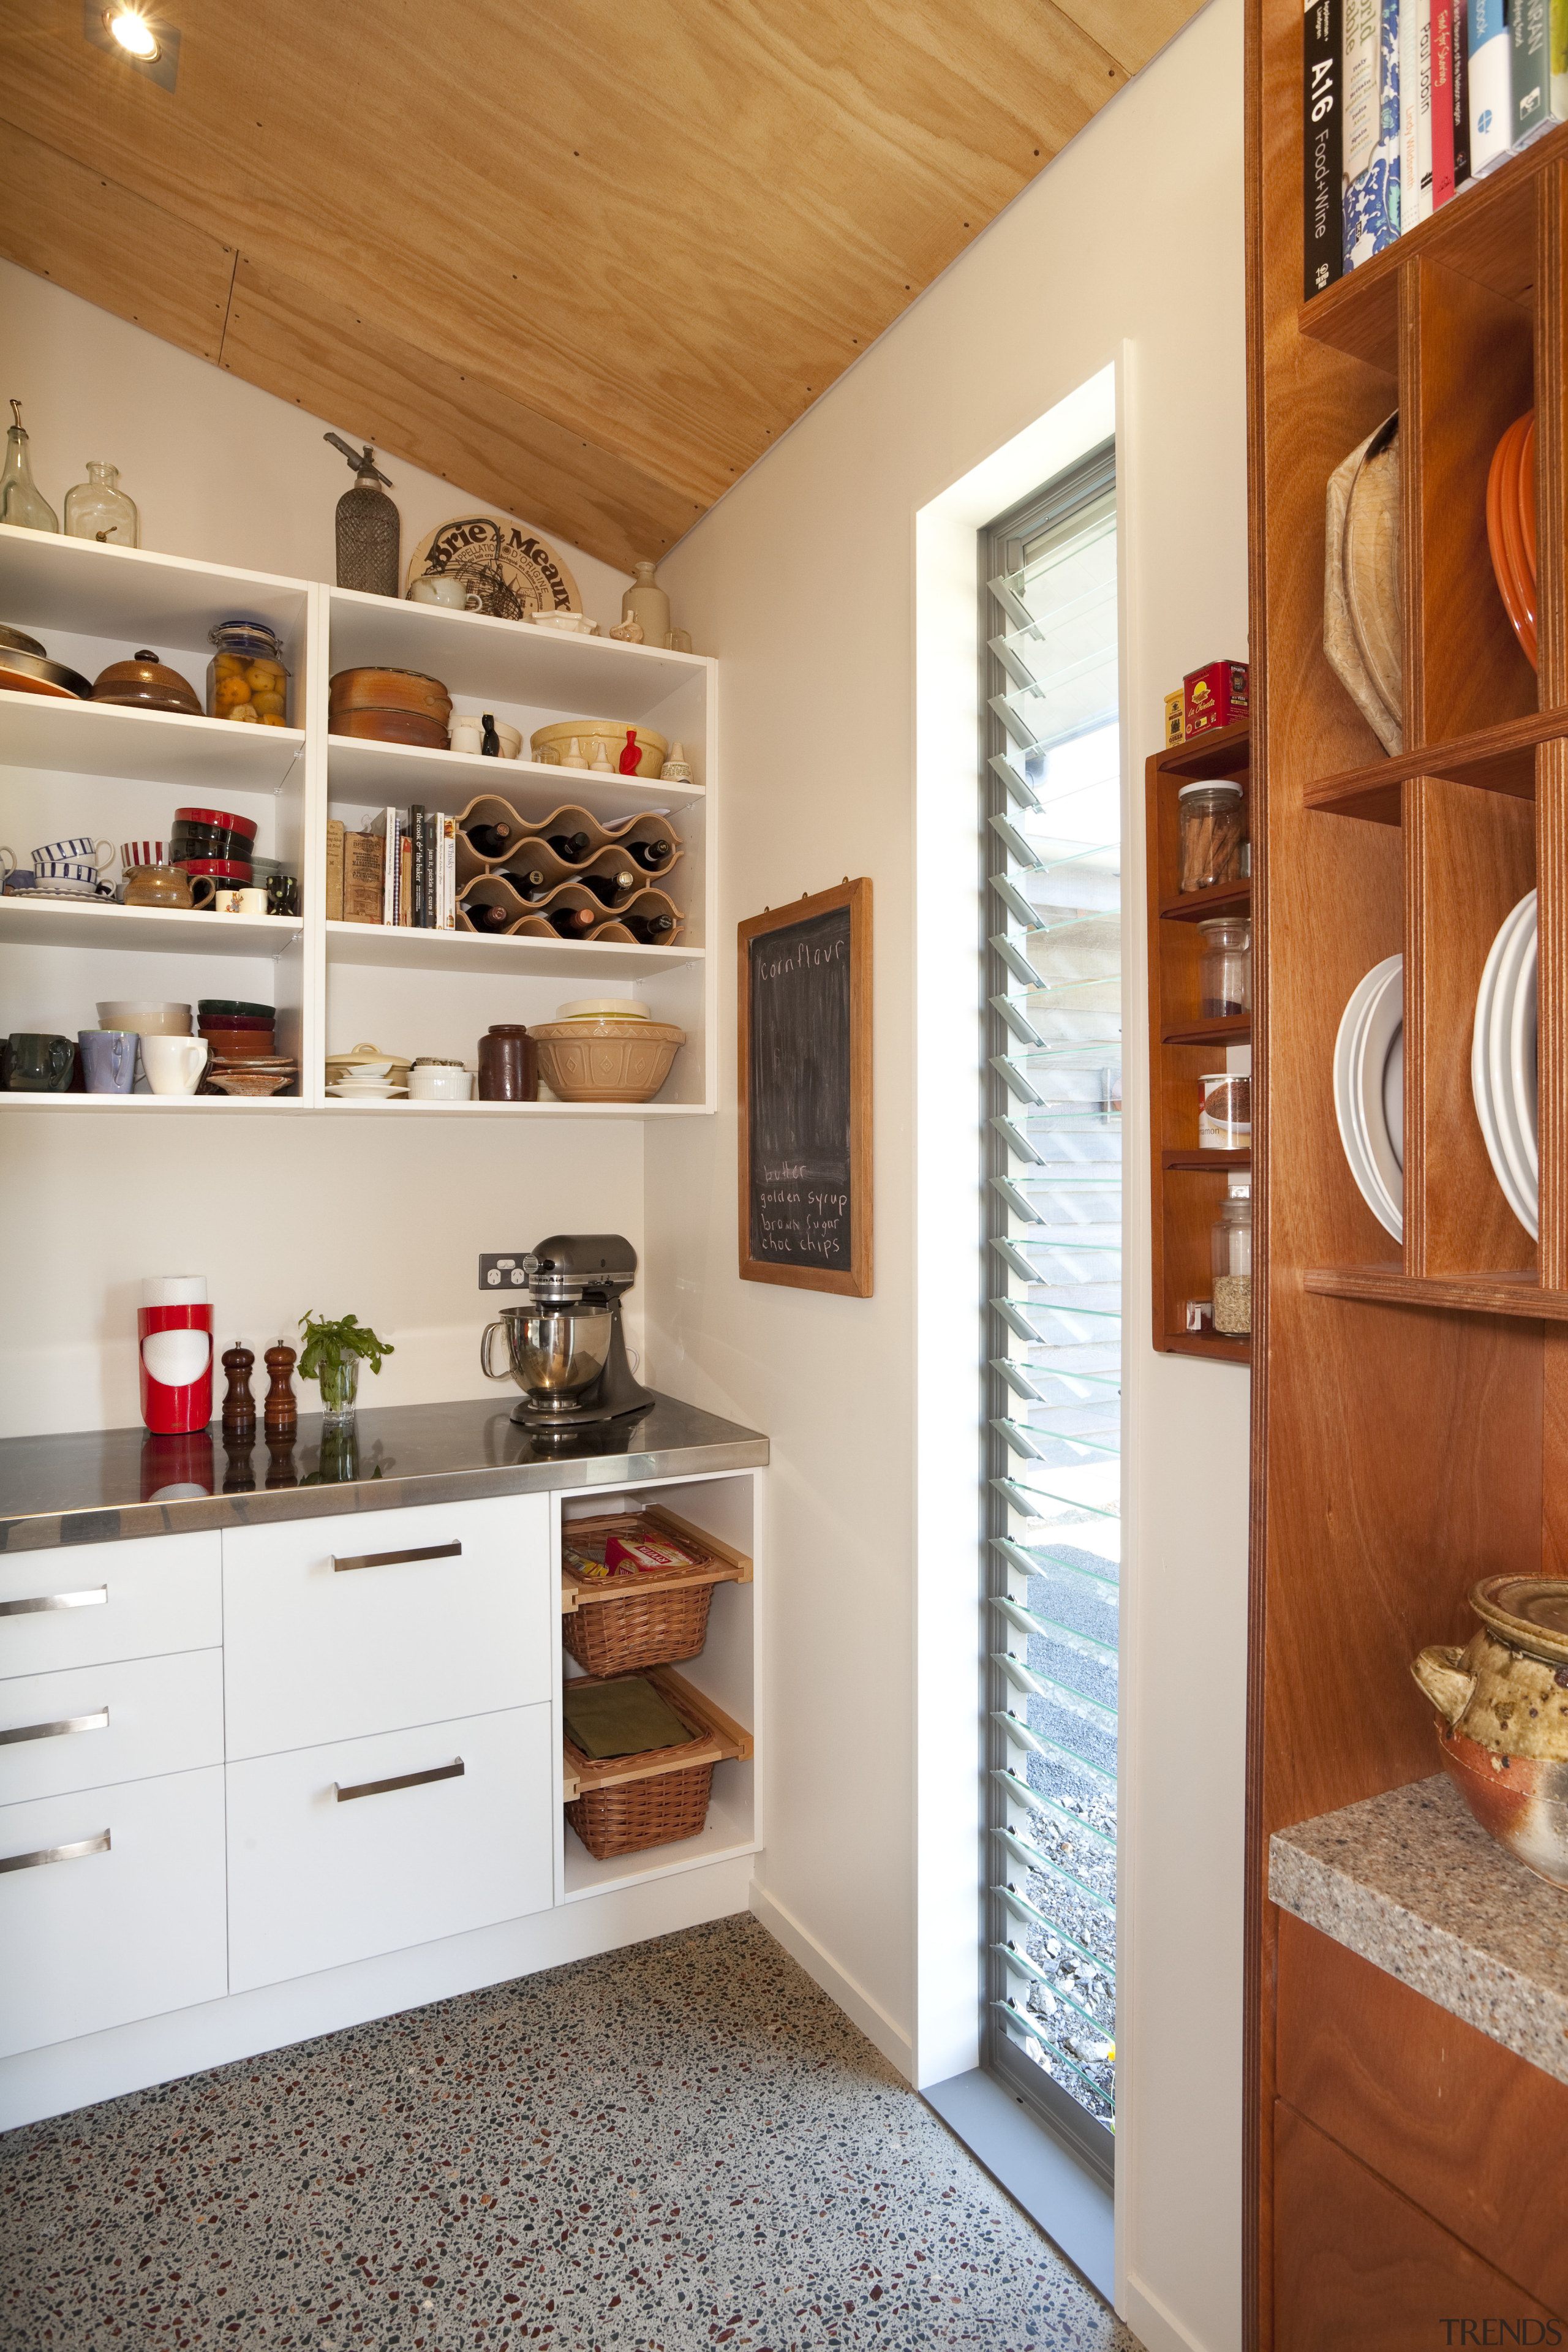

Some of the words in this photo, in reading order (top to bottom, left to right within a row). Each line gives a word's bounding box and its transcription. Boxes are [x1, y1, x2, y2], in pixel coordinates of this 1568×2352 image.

[1420, 22, 1431, 62] Paul
[1434, 46, 1449, 86] Sharing
[1311, 58, 1333, 123] A16
[1350, 78, 1371, 99] Britain
[1420, 67, 1431, 115] Jobin
[1352, 104, 1367, 121] India
[1353, 113, 1366, 127] Asia
[1404, 105, 1415, 135] Lindy
[1350, 134, 1370, 153] Mexico
[1351, 128, 1367, 145] Spain
[1406, 138, 1415, 190] Wildsmith
[1314, 128, 1329, 239] Food+Wine
[424, 525, 488, 567] Brie
[507, 528, 571, 611] Meaux
[500, 554, 518, 566] briqué
[524, 570, 537, 586] Seine
[511, 550, 549, 594] D'ORIGINE
[1169, 711, 1183, 721] MUSTARD
[1188, 708, 1194, 717] La
[1196, 698, 1215, 714] Chinata
[1169, 733, 1183, 743] QUEEN
[417, 841, 423, 851] &
[352, 861, 380, 869] MANAGEMENT
[760, 1190, 801, 1210] golden
[761, 1213, 800, 1231] brown
[762, 1232, 792, 1251] choc
[800, 1234, 840, 1259] chips
[638, 1547, 667, 1564] RYVITA
